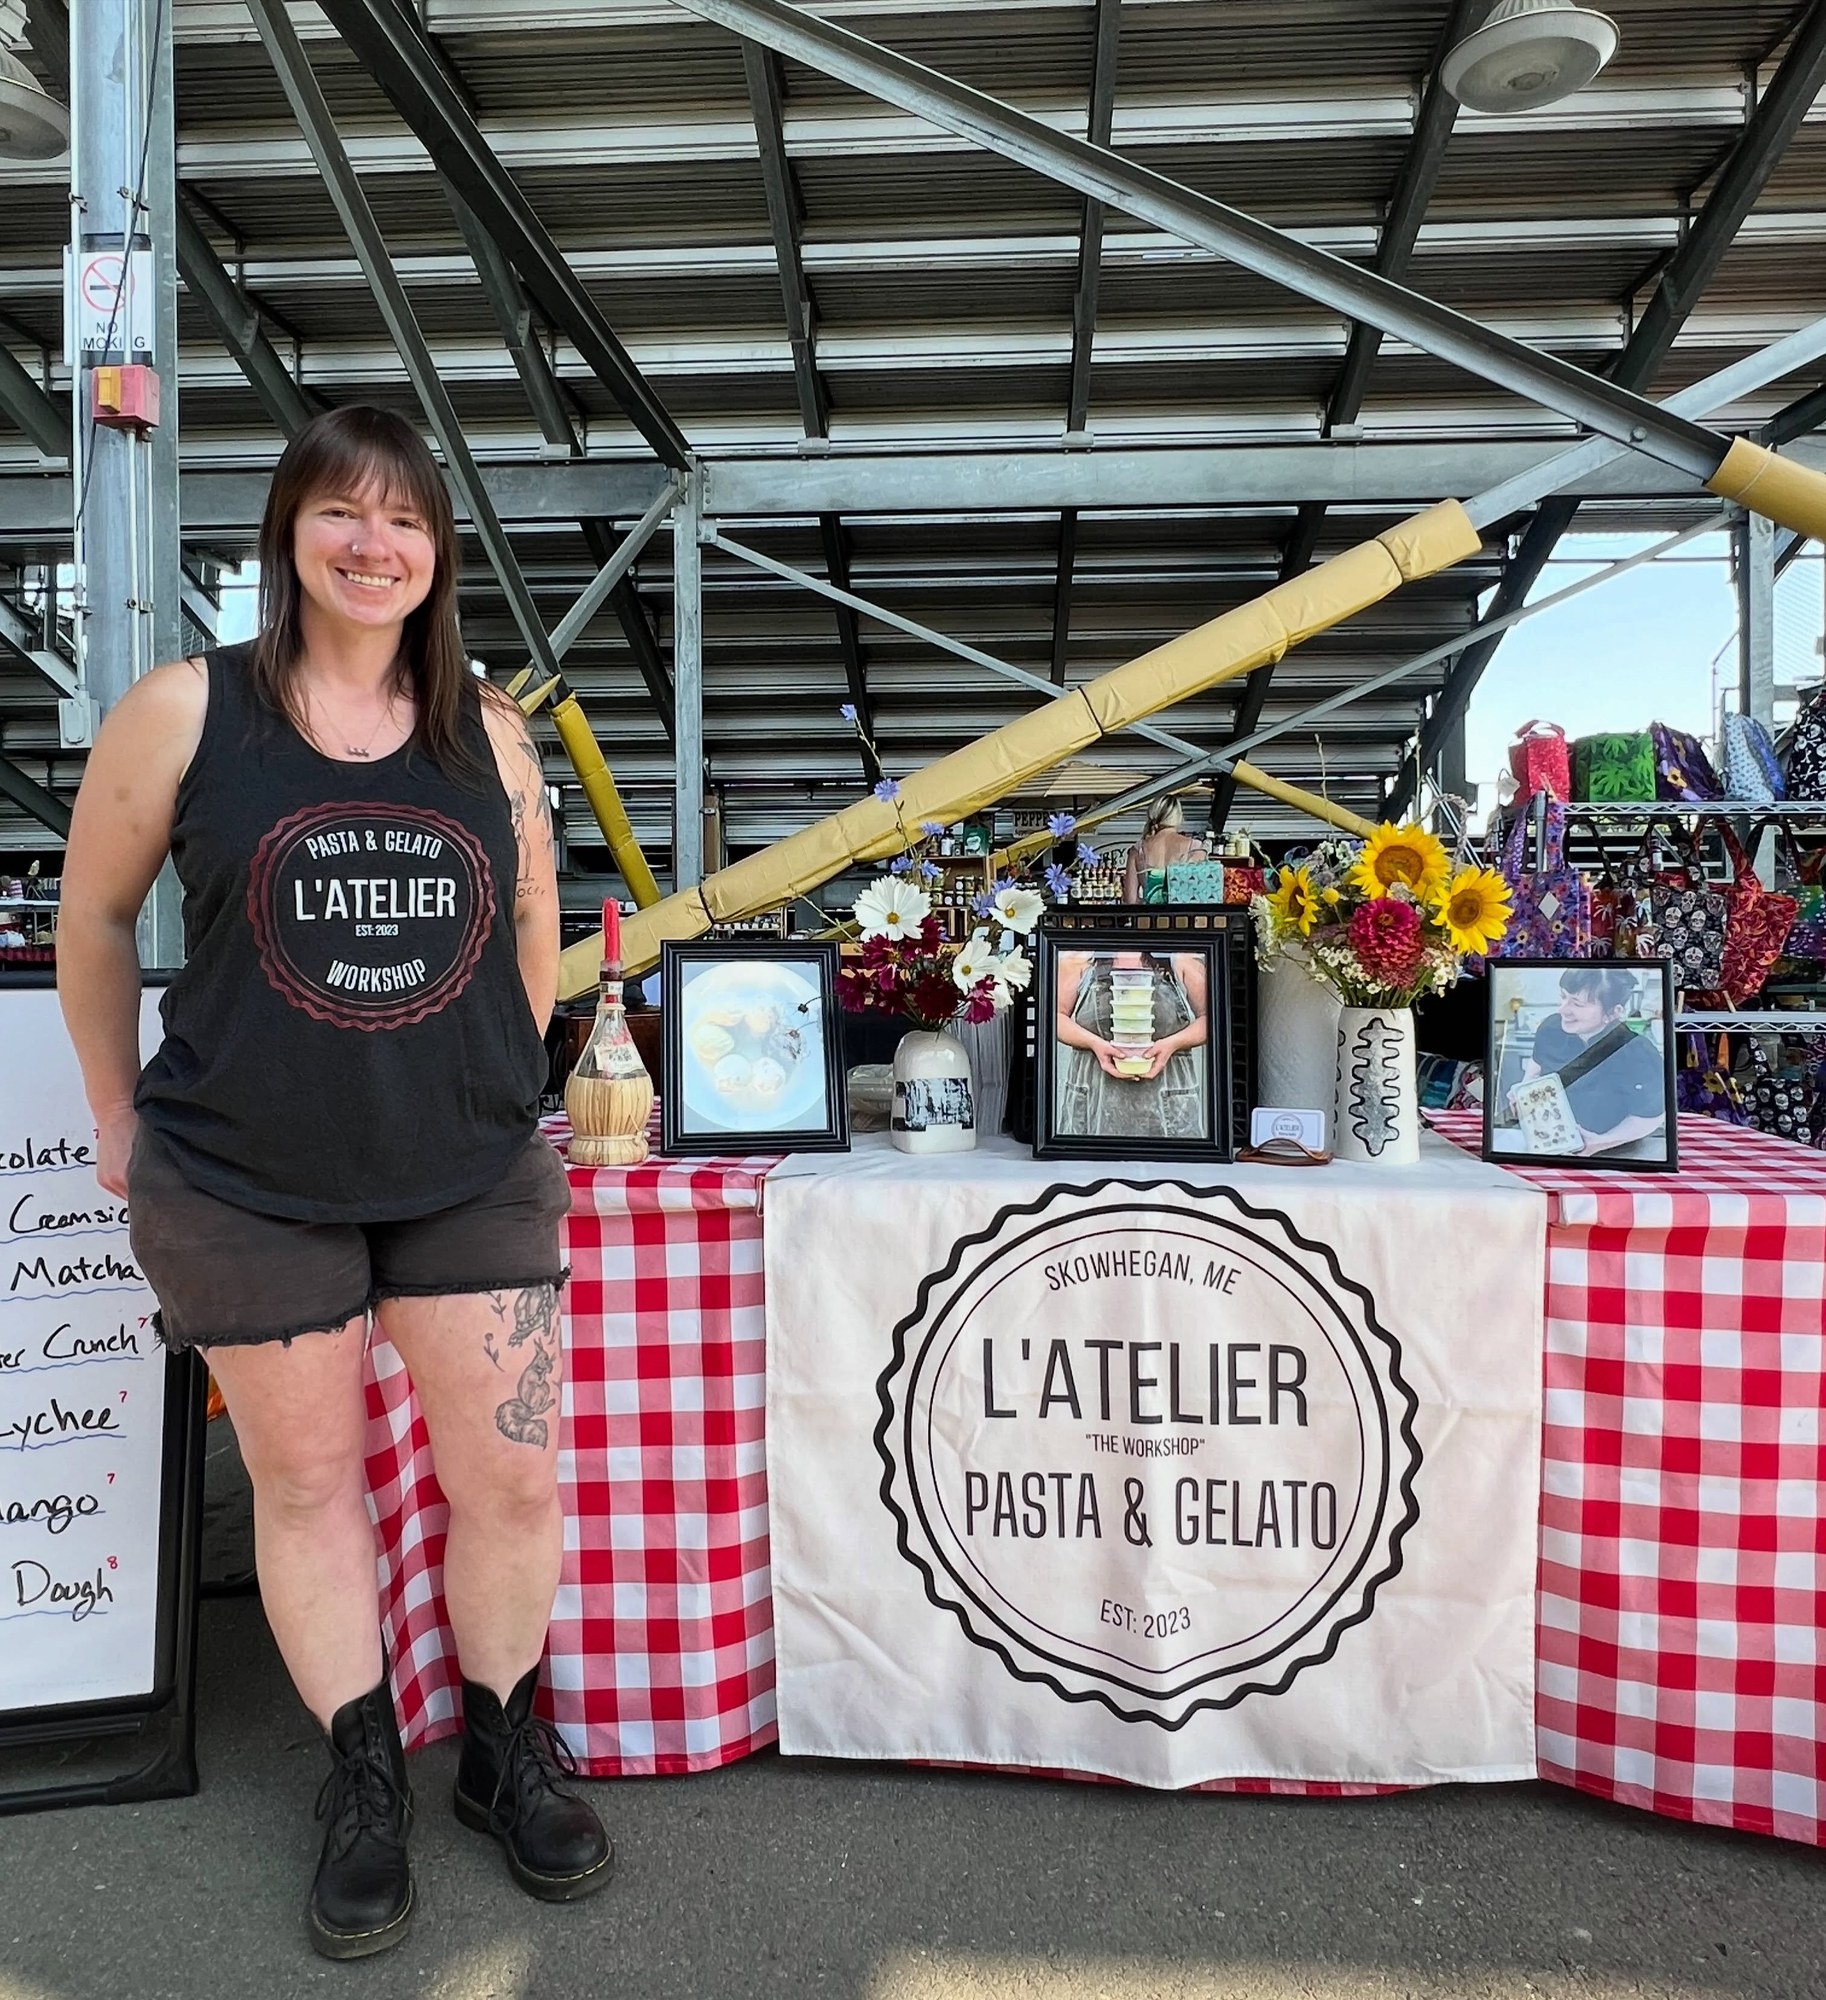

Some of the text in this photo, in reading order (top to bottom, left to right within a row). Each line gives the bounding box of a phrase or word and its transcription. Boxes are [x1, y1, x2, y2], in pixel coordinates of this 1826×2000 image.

[83, 336, 146, 349] MOKIG
[96, 322, 119, 334] NO
[1014, 811, 1058, 827] PEPPE
[305, 830, 443, 859] PASTA & GELATO
[294, 878, 457, 921] L'ATELIER
[375, 924, 399, 936] 2023
[326, 959, 426, 992] WORKSHOP
[10, 1254, 145, 1291] Matcha
[1043, 1249, 1242, 1295] SKOWHEGAN, ME
[43, 1323, 139, 1359] Crunch
[137, 1317, 149, 1328] 7
[119, 1390, 128, 1403] 7
[982, 1337, 1309, 1427] L'ATELIER
[1085, 1434, 1206, 1458] "THE WORKSHOP"
[0, 1473, 115, 1534] ango 7
[964, 1470, 1337, 1550] PASTA & GELATO
[11, 1556, 118, 1622] Dough 8
[1099, 1598, 1192, 1639] EST: 2023
